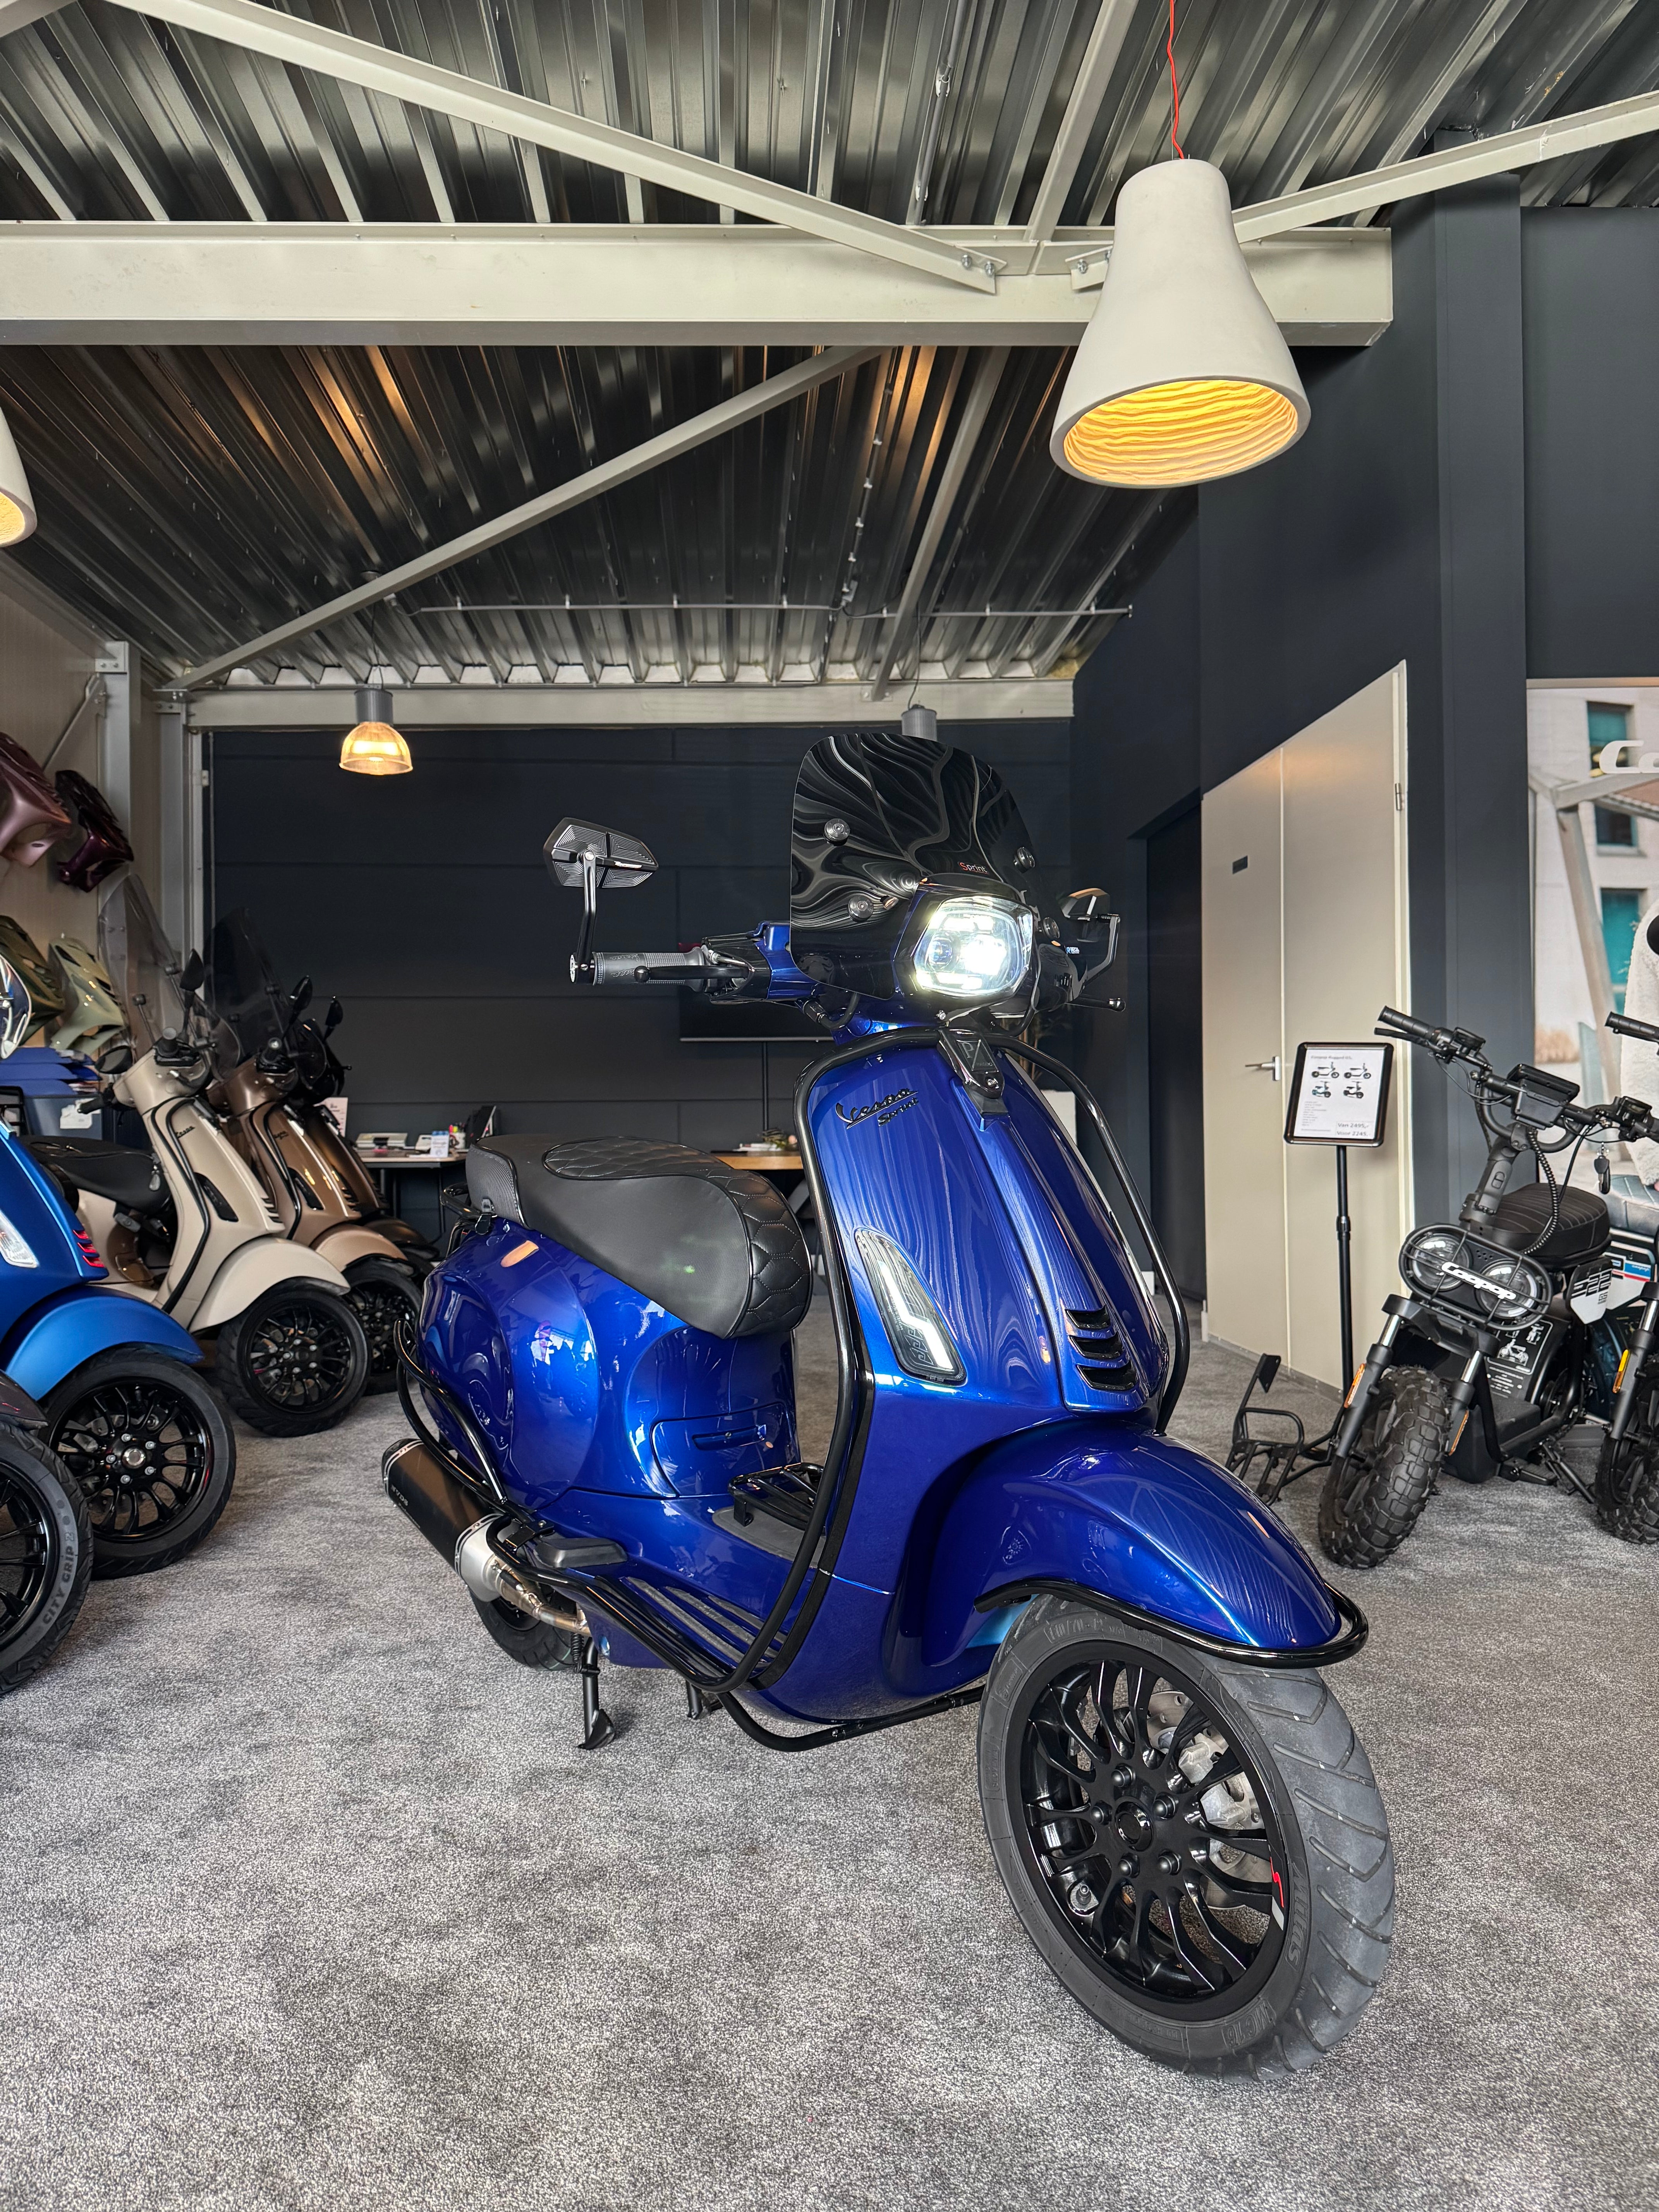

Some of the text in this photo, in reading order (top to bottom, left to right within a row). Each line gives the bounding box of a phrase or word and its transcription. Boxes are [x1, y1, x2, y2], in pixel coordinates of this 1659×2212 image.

[959, 862, 988, 873] Sprint
[835, 1088, 919, 1130] Vespa
[877, 1097, 919, 1127] Sprint
[1441, 1262, 1516, 1300] Coopop
[42, 1532, 75, 1625] CITY GRIP 2
[1288, 1862, 1309, 1967] Mitas
